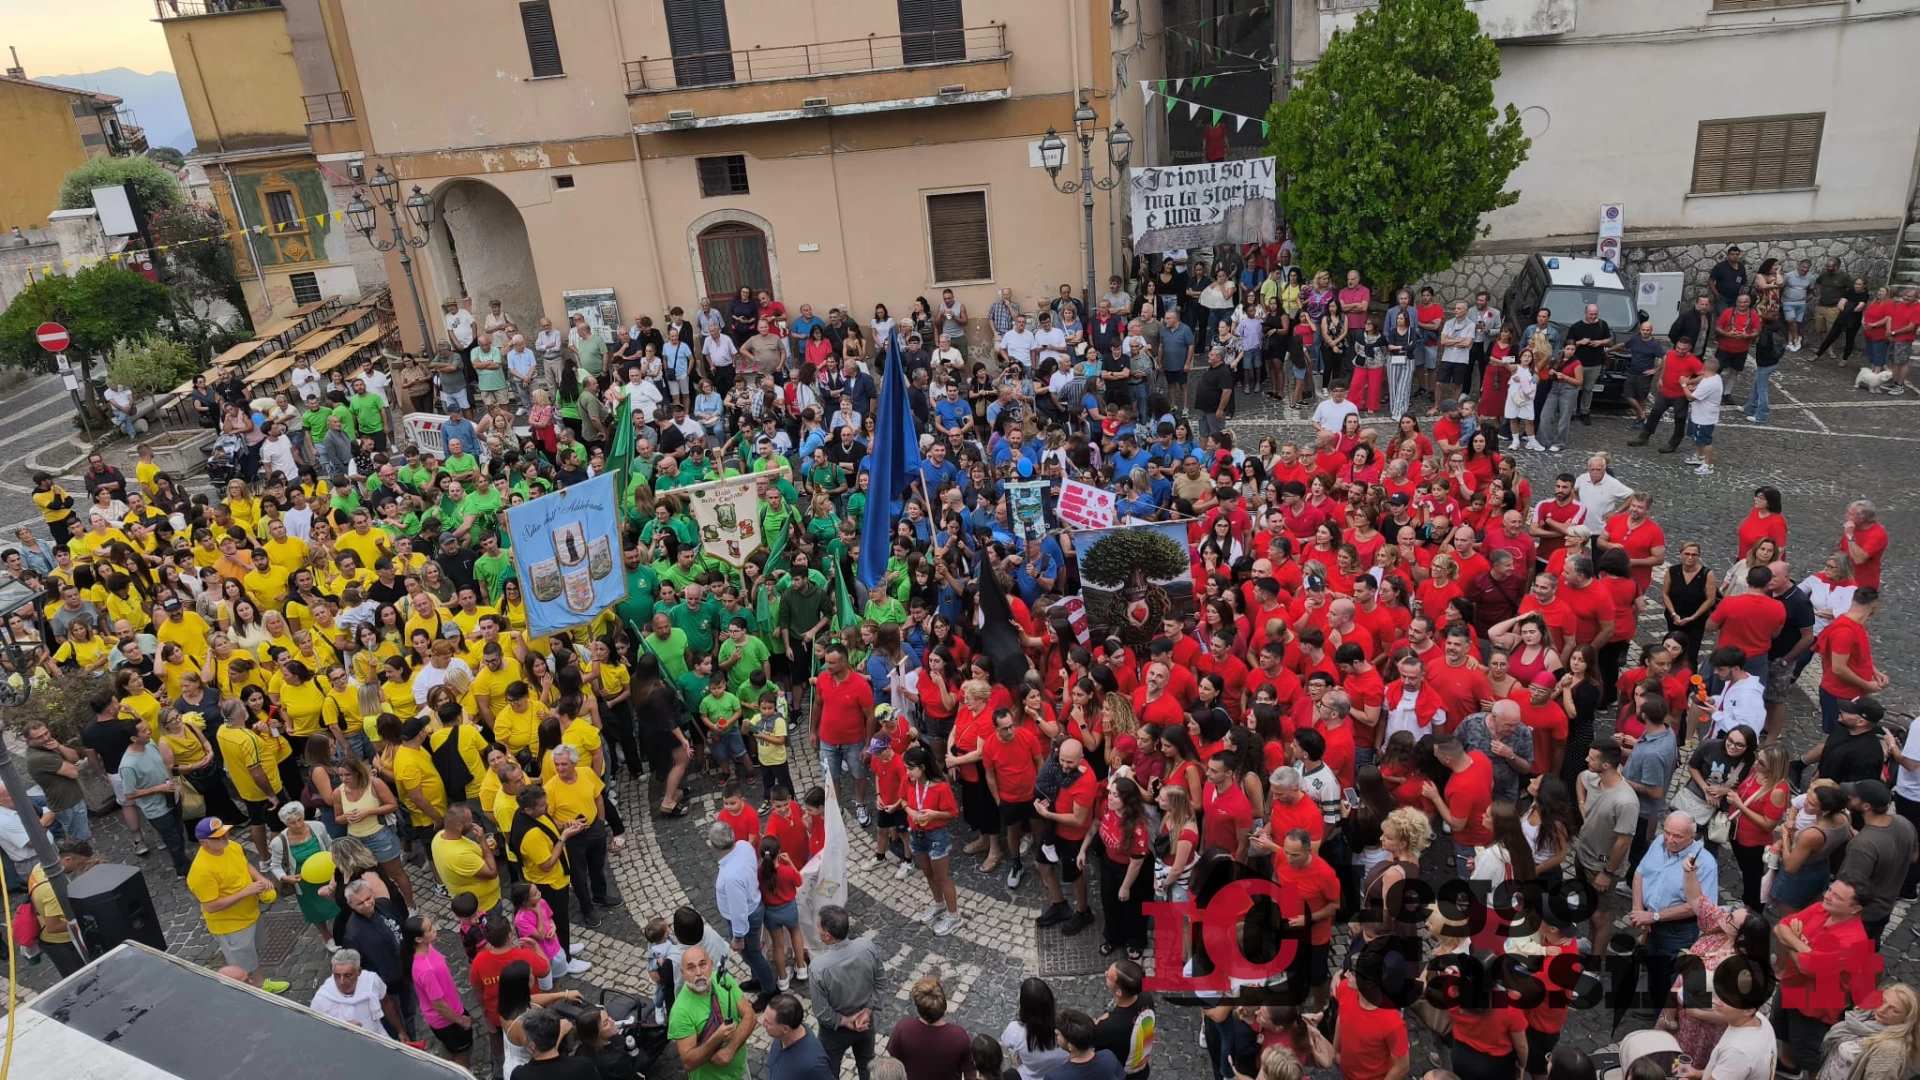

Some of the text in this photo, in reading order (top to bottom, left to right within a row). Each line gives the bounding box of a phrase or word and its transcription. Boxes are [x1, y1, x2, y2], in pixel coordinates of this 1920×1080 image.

[1144, 180, 1262, 210] ma la storia
[1164, 207, 1201, 226] una
